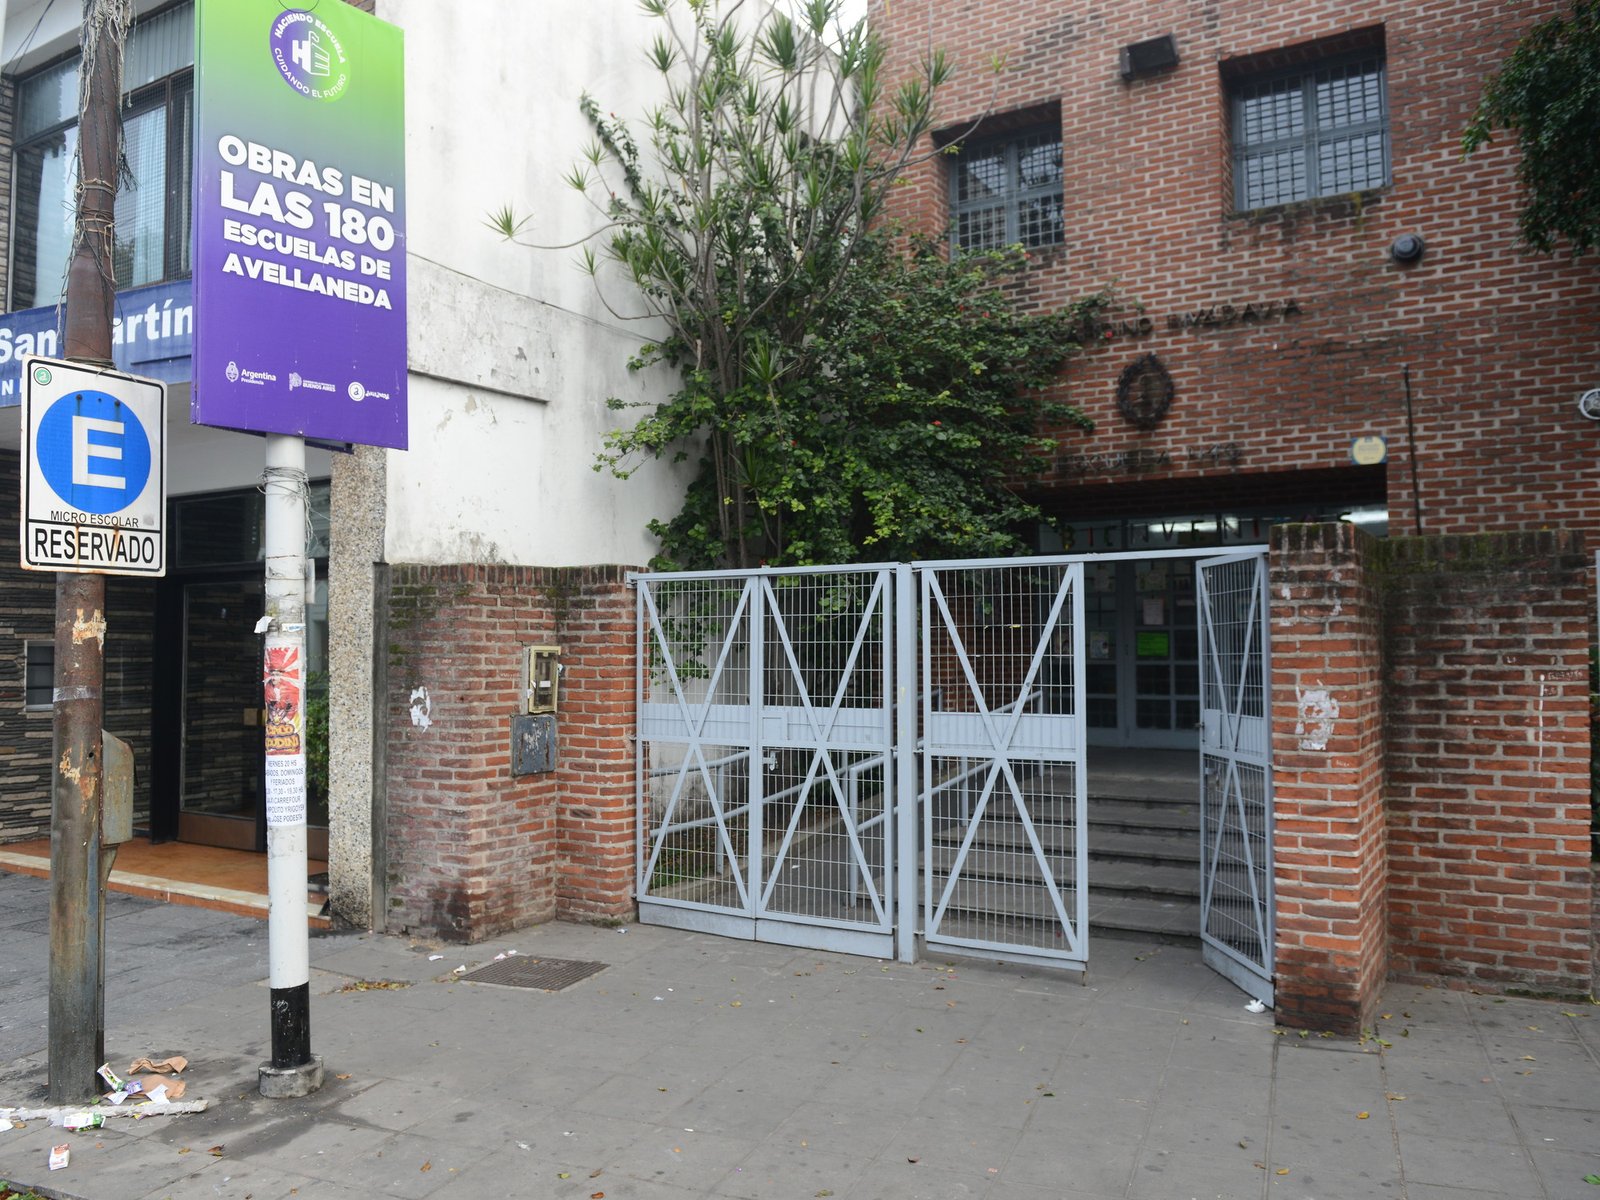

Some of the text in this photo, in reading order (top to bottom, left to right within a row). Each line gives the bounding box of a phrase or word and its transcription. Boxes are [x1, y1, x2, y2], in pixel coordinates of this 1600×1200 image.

[274, 13, 346, 64] HACIENDO ESCUELA
[274, 47, 346, 98] CUIDANDO EL FUTURO
[218, 134, 394, 213] OBRAS EN
[220, 170, 395, 251] LAS 180
[223, 218, 391, 281] ESCUELAS DE
[222, 252, 392, 310] AVELLANEDA
[0, 298, 192, 364] San artín
[241, 369, 277, 382] Argentina
[72, 415, 126, 490] E
[34, 527, 155, 564] RESERVADO
[50, 510, 139, 528] MICRO ESCOLAR
